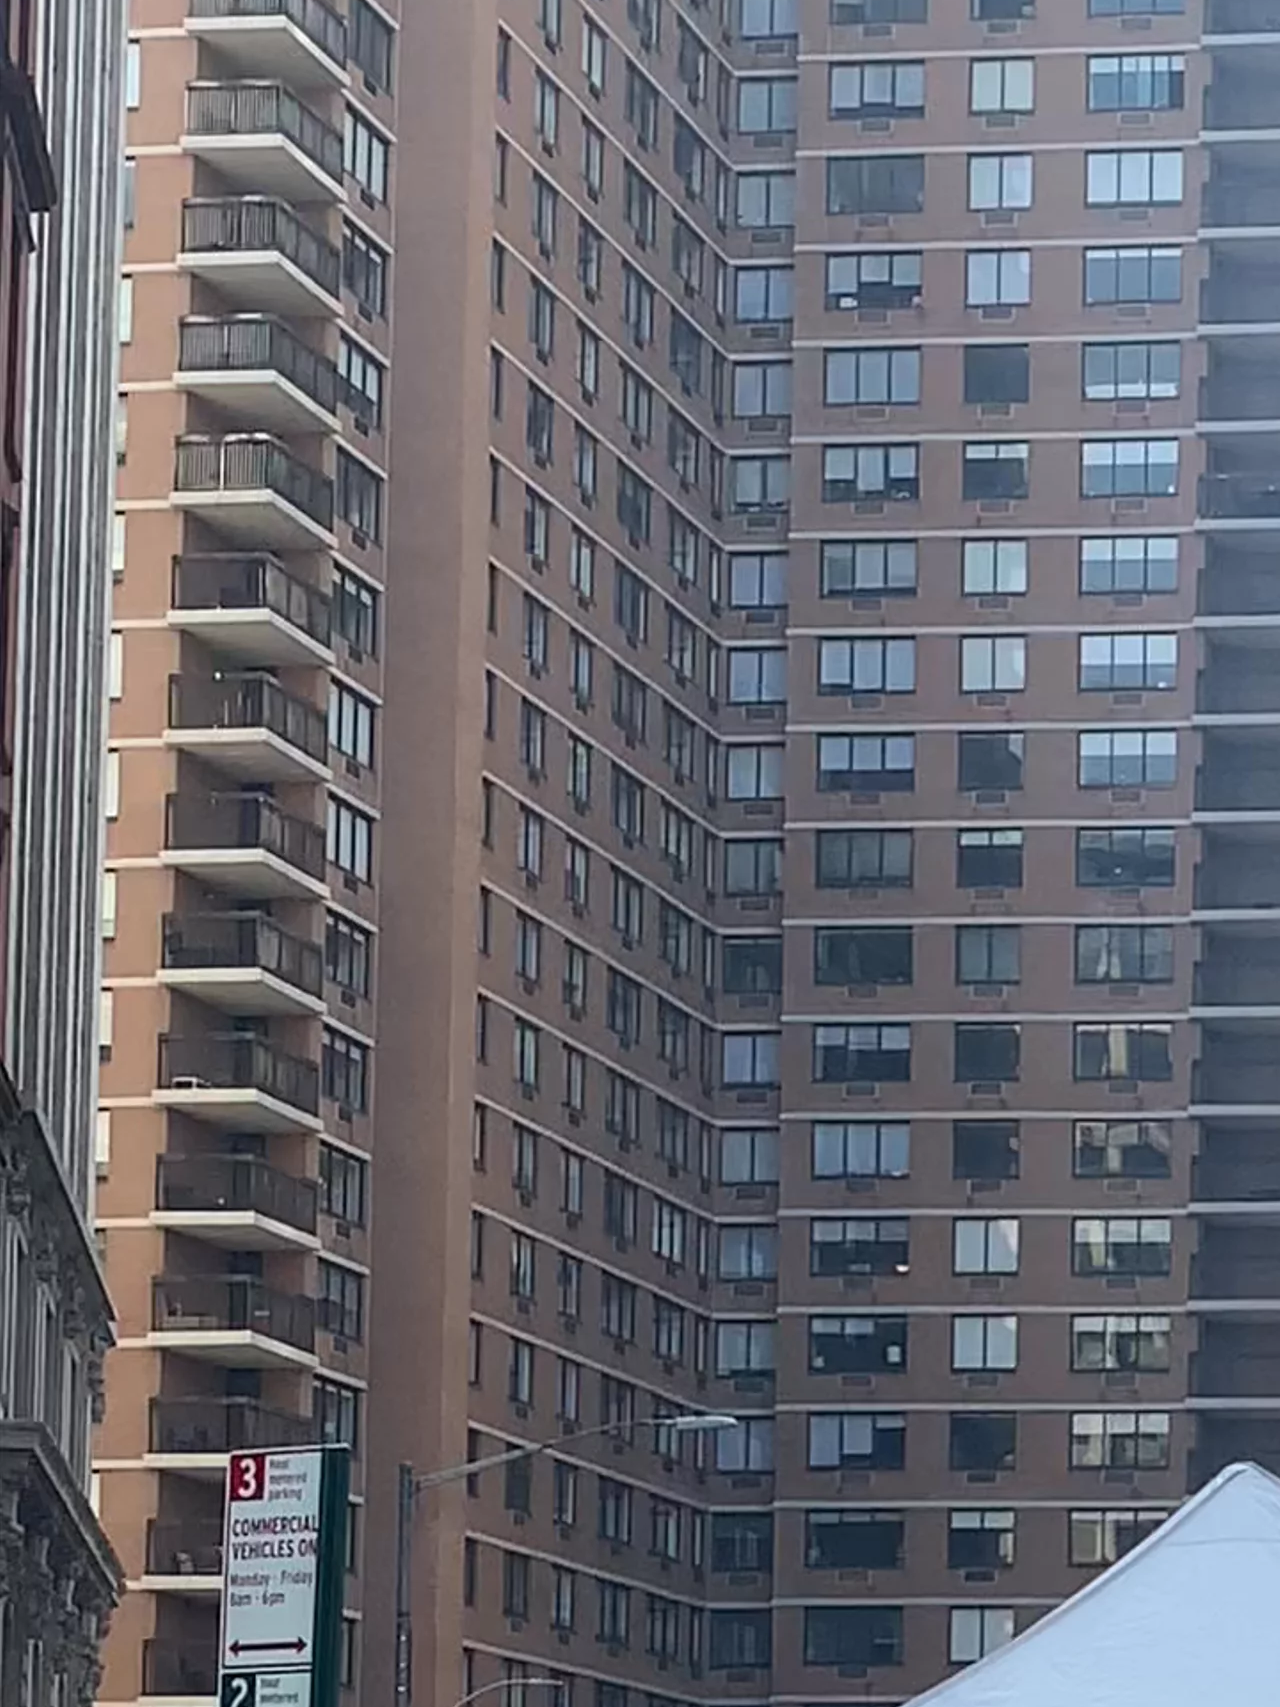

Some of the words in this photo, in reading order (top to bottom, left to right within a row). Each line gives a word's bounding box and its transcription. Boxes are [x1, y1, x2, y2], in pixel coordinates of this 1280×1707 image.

[237, 1458, 257, 1497] 3
[269, 1471, 307, 1485] metered
[269, 1487, 302, 1501] parking
[232, 1514, 318, 1537] COMMERCIAL
[231, 1540, 294, 1560] VEHICLES
[230, 1571, 270, 1587] Monday
[280, 1570, 313, 1587] Friday
